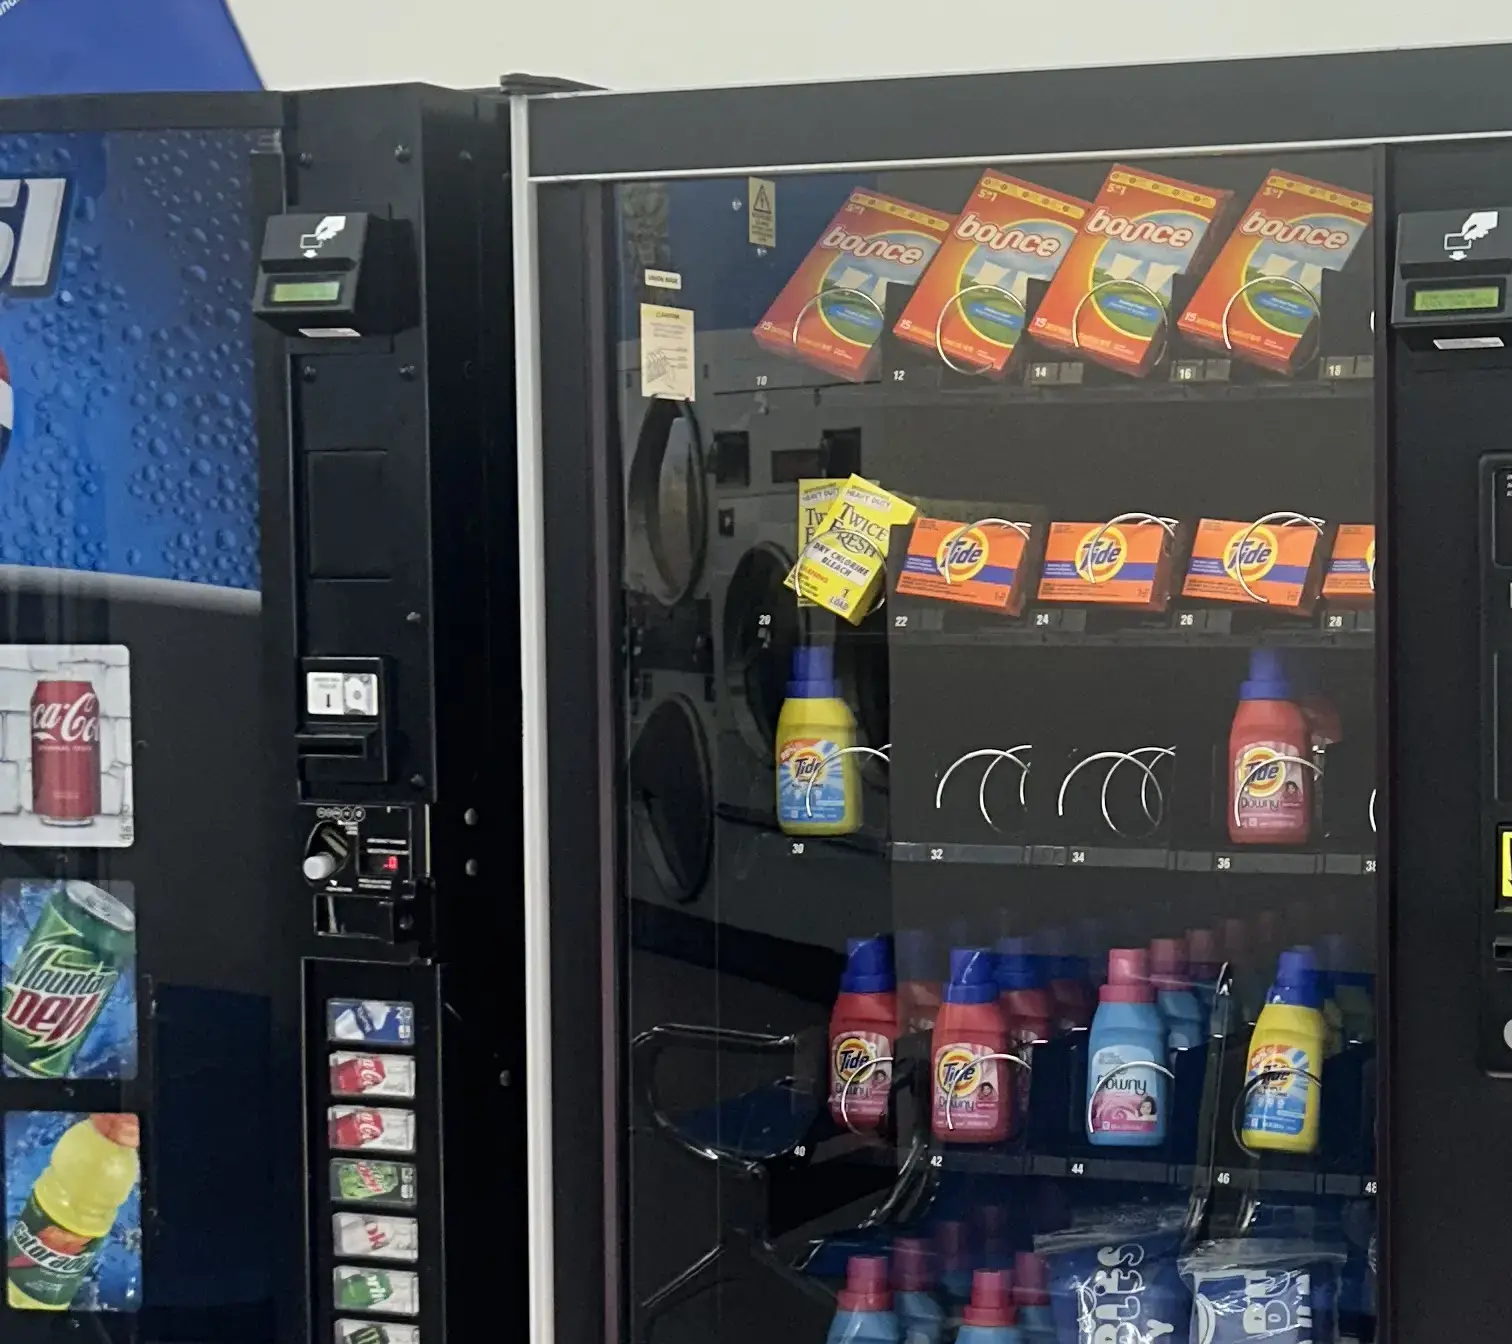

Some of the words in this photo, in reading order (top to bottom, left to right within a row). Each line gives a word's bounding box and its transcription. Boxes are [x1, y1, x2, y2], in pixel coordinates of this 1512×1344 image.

[1086, 206, 1193, 248] bounce
[1241, 208, 1349, 250] bounce
[956, 213, 1061, 257] bounce
[822, 224, 925, 265] bounce
[893, 370, 905, 381] 12
[1034, 367, 1047, 378] 14
[1179, 369, 1192, 380] 16
[1328, 365, 1341, 376] 18
[756, 376, 767, 386] 10
[839, 502, 889, 542] TWICE
[758, 615, 771, 625] 20
[895, 617, 908, 627] 22
[1036, 615, 1049, 625] 24
[1180, 615, 1193, 625] 26
[1329, 616, 1342, 627] 28
[792, 843, 805, 854] 30
[931, 848, 943, 859] 32
[1073, 852, 1085, 863] 34
[1217, 858, 1231, 869] 36
[794, 1146, 805, 1157] 40
[931, 1156, 943, 1167] 42
[1071, 1164, 1084, 1174] 44
[1217, 1172, 1230, 1184] 46
